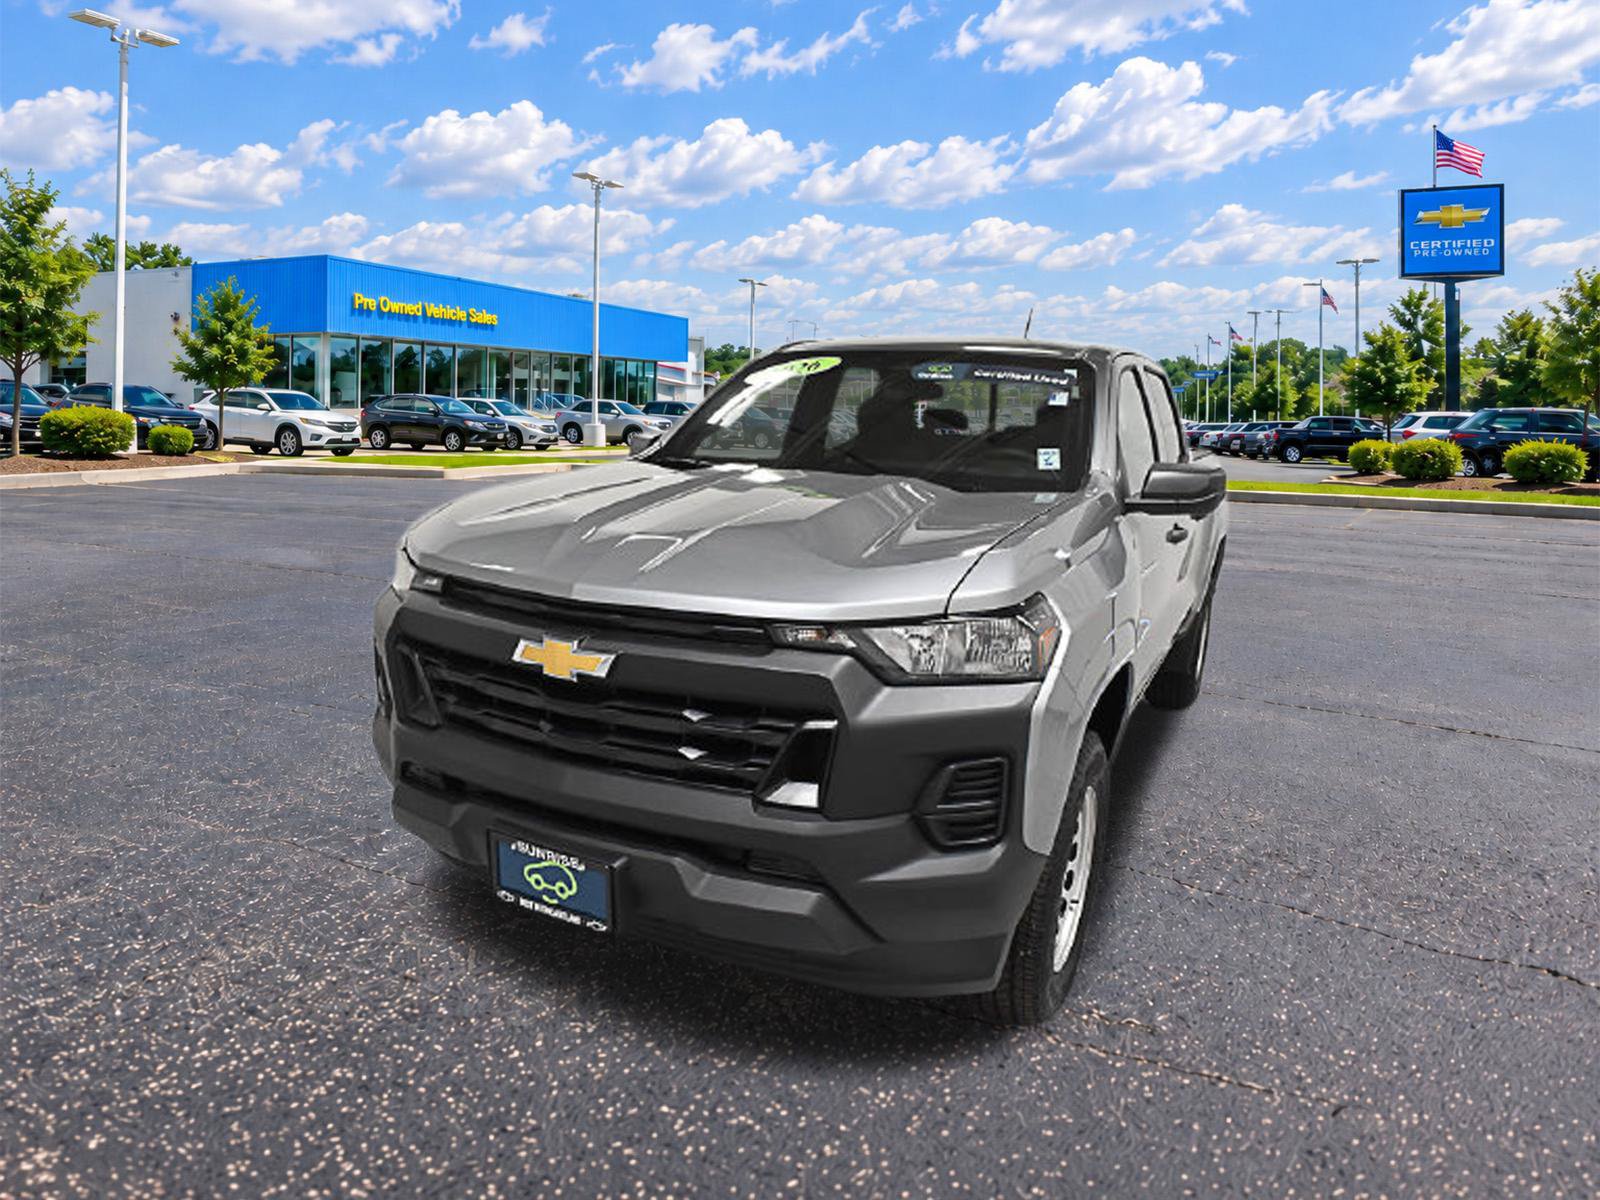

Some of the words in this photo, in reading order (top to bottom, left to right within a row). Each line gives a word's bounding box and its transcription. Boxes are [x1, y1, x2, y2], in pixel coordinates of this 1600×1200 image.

[1409, 238, 1495, 250] CERTIFIED
[1413, 247, 1490, 258] PRE-OWNED
[353, 292, 376, 311] Pre
[379, 295, 422, 317] Owned
[424, 301, 467, 322] Vehicle
[469, 307, 498, 326] Sales
[1034, 373, 1069, 386] Used
